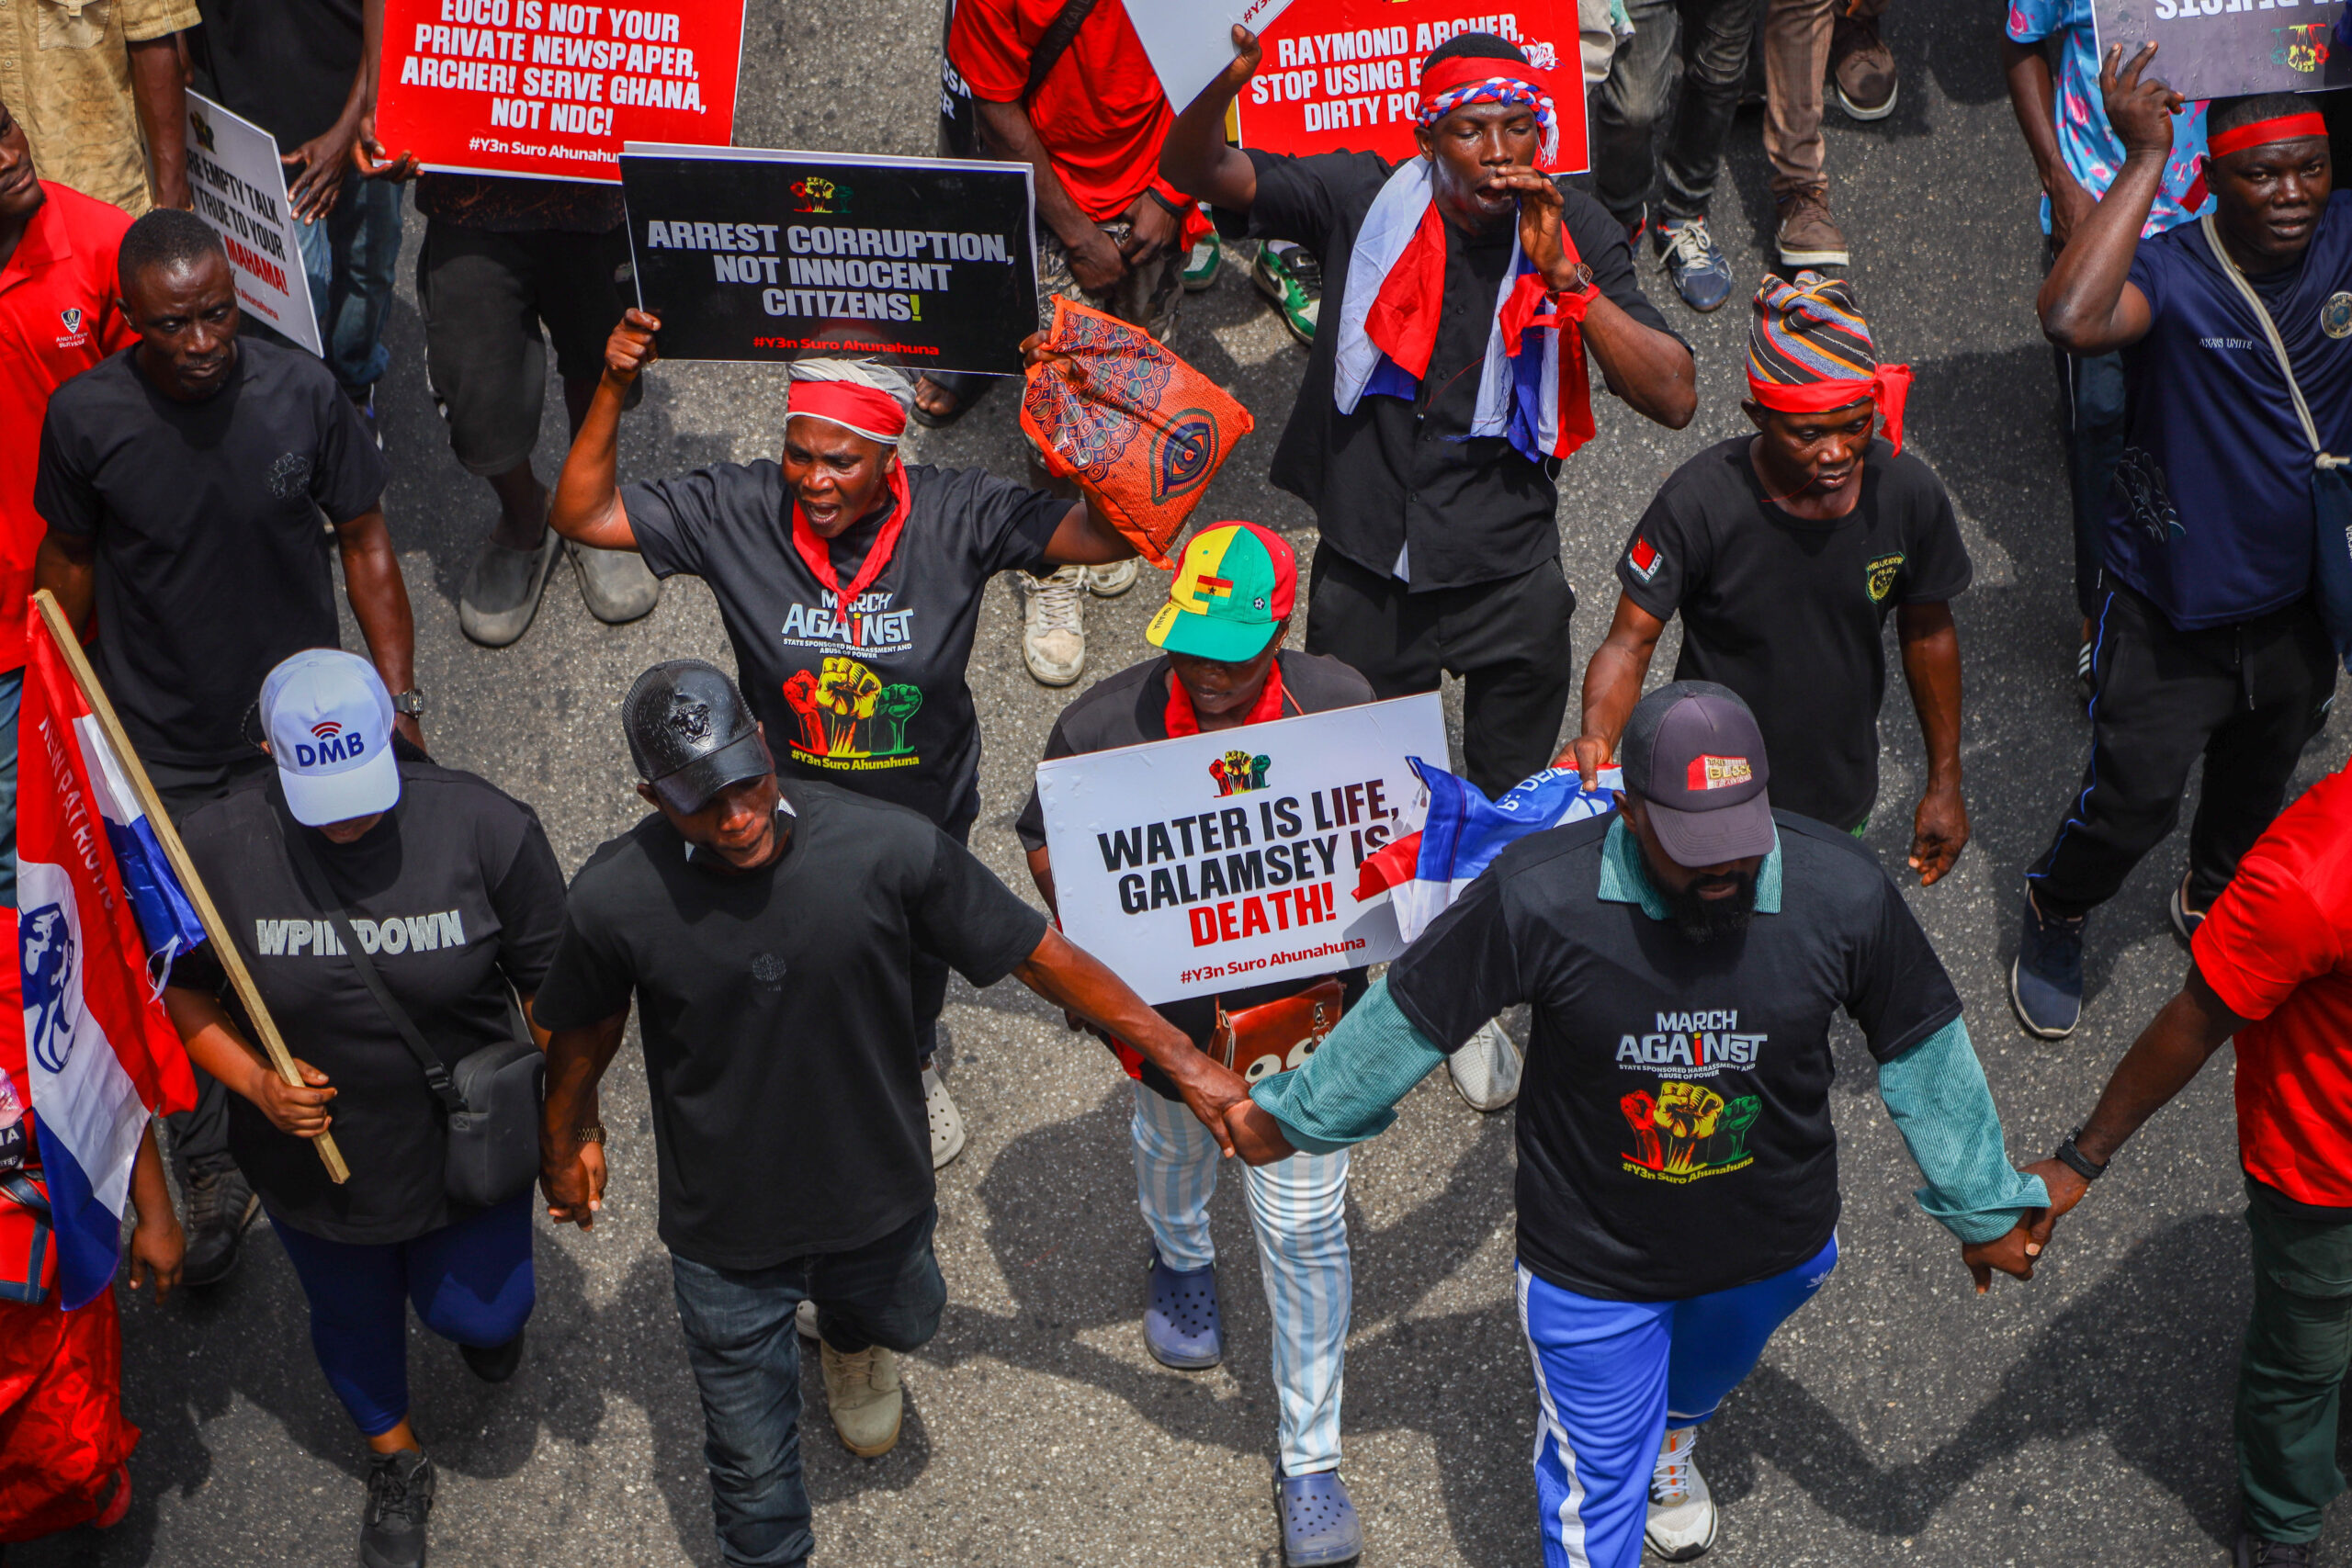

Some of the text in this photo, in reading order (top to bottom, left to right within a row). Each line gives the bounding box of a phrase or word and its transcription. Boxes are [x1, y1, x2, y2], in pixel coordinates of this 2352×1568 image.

[515, 0, 543, 30] IS
[548, 3, 603, 36] NOT
[609, 8, 680, 43] YOUR
[1243, 0, 1271, 24] #Y3
[414, 23, 699, 81] PRIVATE NEWSPAPER,
[1278, 26, 1408, 68] RAYMOND
[400, 55, 707, 116] ARCHER! SERVE GHANA,
[1250, 69, 1318, 106] STOP
[1324, 60, 1404, 95] USING
[491, 96, 614, 136] NOT NDC!
[1304, 96, 1381, 132] DIRTY
[469, 136, 619, 164] #Y3n Suro Ahunahu
[202, 157, 245, 206] EMPTY
[244, 183, 285, 231] TALK,
[196, 185, 232, 229] TRUE
[228, 205, 249, 239] TO
[246, 216, 286, 263] YOUR
[647, 220, 1014, 265] ARREST CORRUPTION,
[224, 233, 289, 297] MAHAMA!
[714, 254, 953, 290] NOT INNOCENT
[763, 288, 922, 321] CITIZENS!
[752, 337, 940, 356] #Y3n Suro Ahunahuna
[821, 589, 893, 613] MRCH
[783, 638, 805, 647] STATE
[852, 650, 877, 659] POWER
[295, 731, 365, 767] DMB
[791, 750, 920, 771] #Y3n Suro Ahunahuna
[1097, 779, 1399, 873] WATER IS LIFE,
[1118, 833, 1340, 916] GALAMSEY
[1188, 881, 1337, 948] DEATH!
[1181, 937, 1366, 984] #Y3n Suro Ahunahuna
[1657, 1010, 1738, 1032] MARCH
[1642, 1065, 1687, 1074] SPONSORED
[1741, 1063, 1756, 1072] AND
[1694, 1069, 1719, 1078] POWER
[1623, 1156, 1754, 1185] #Y3n Suro Ahunahuna
